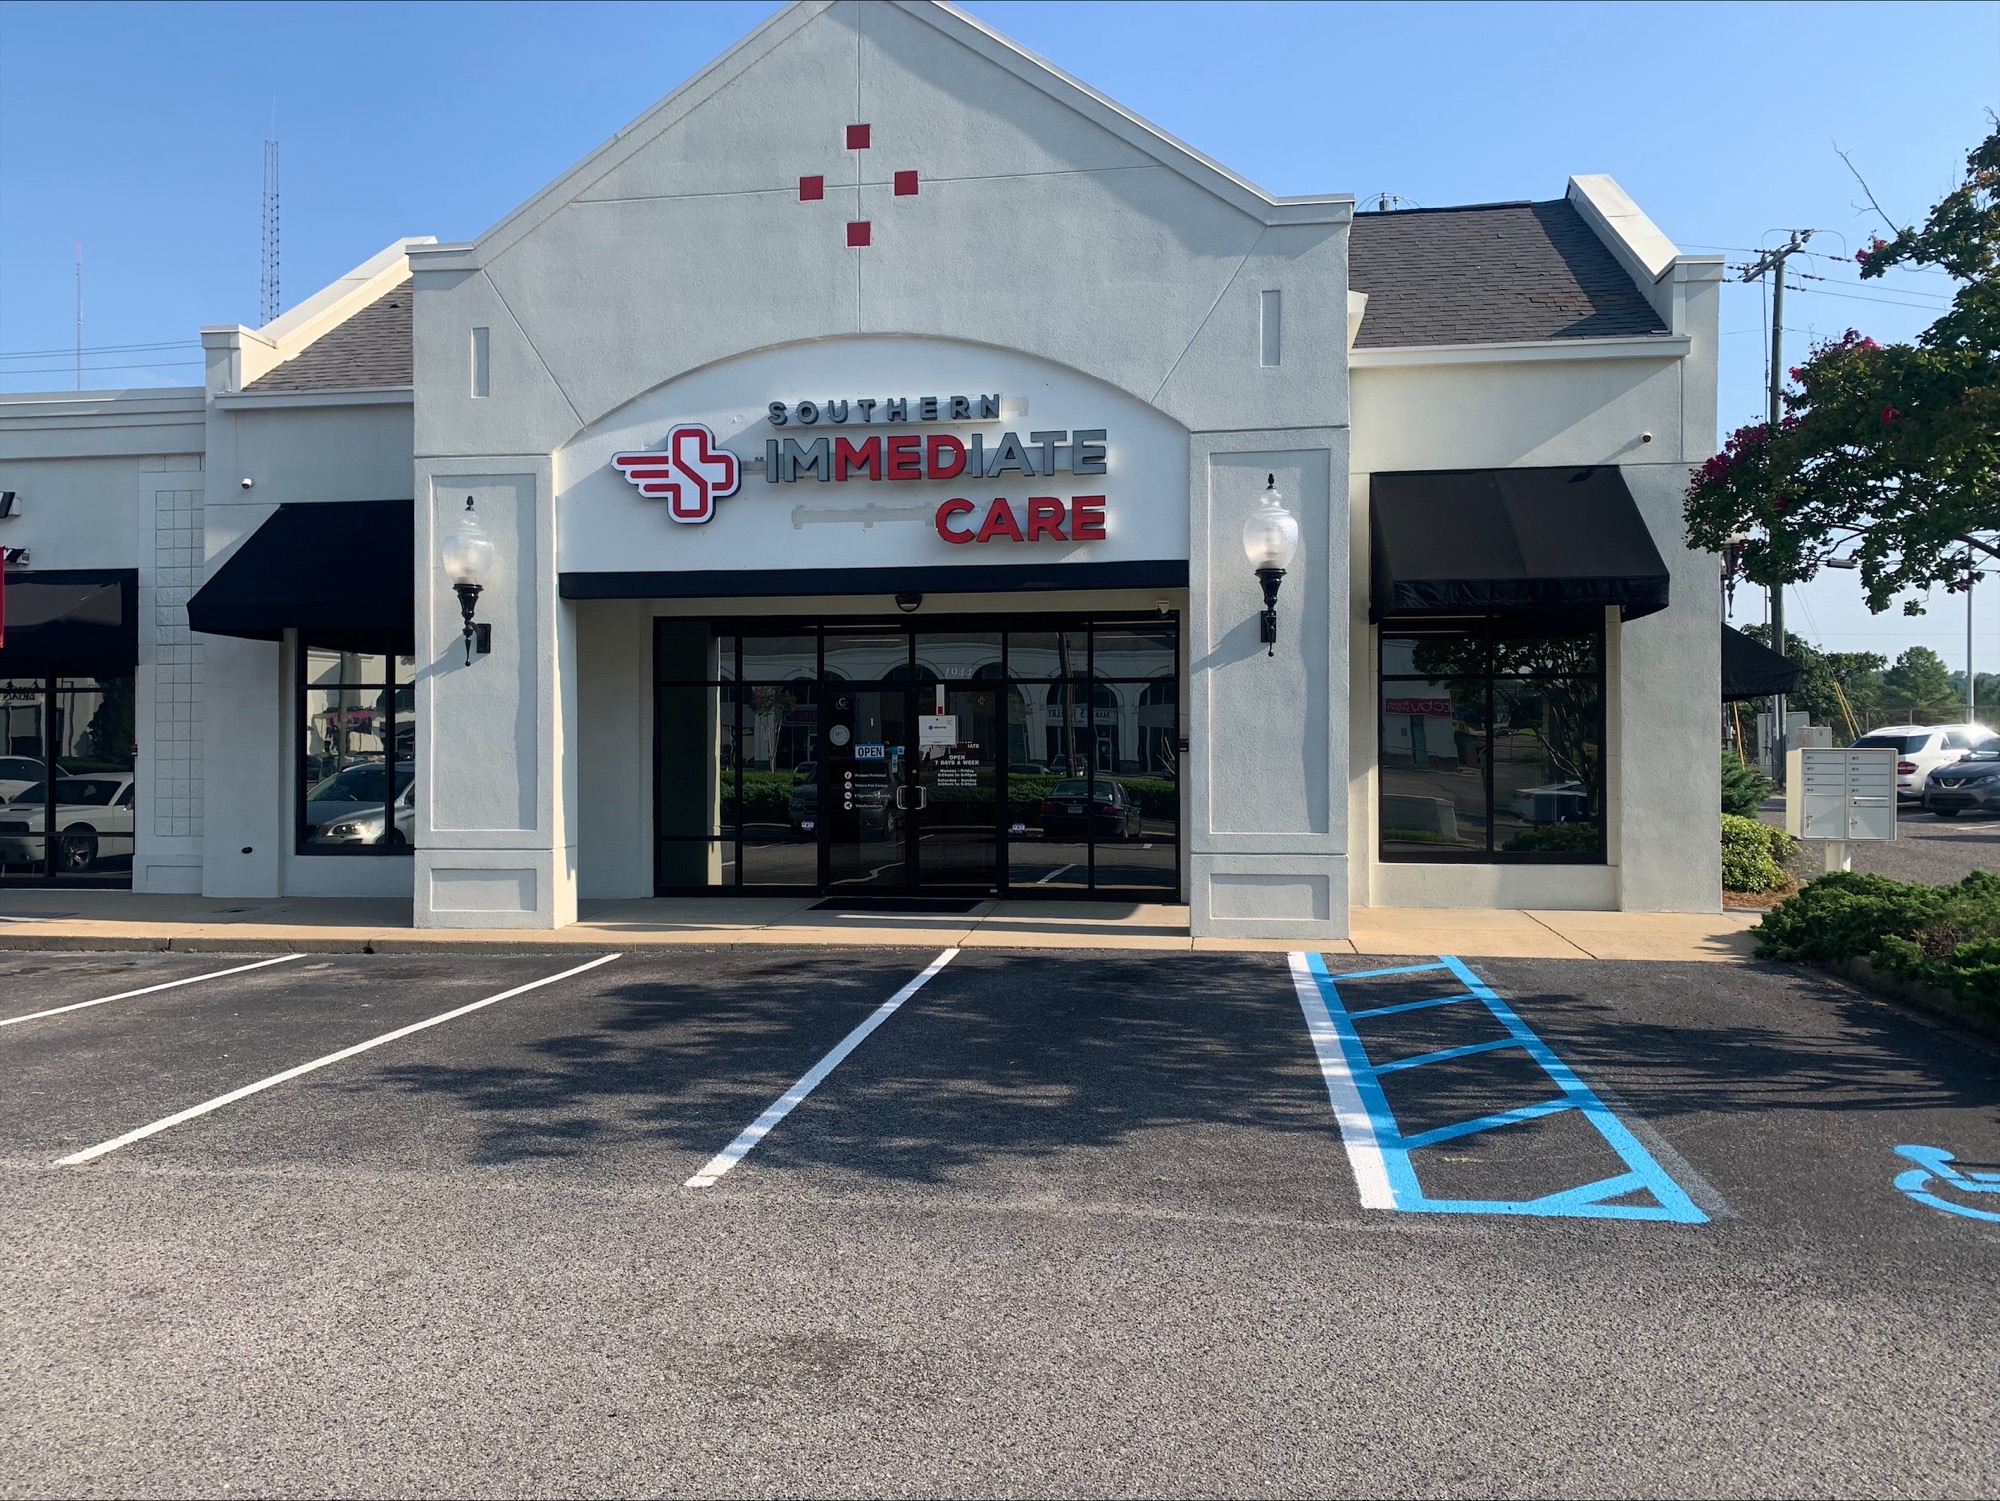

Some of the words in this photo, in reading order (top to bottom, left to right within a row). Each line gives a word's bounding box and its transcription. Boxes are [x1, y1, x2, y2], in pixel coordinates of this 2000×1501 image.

[768, 394, 1001, 425] SOUTHERN
[765, 429, 1107, 484] IMMEDIATE
[935, 494, 1107, 545] CARE
[858, 747, 882, 757] OPEN
